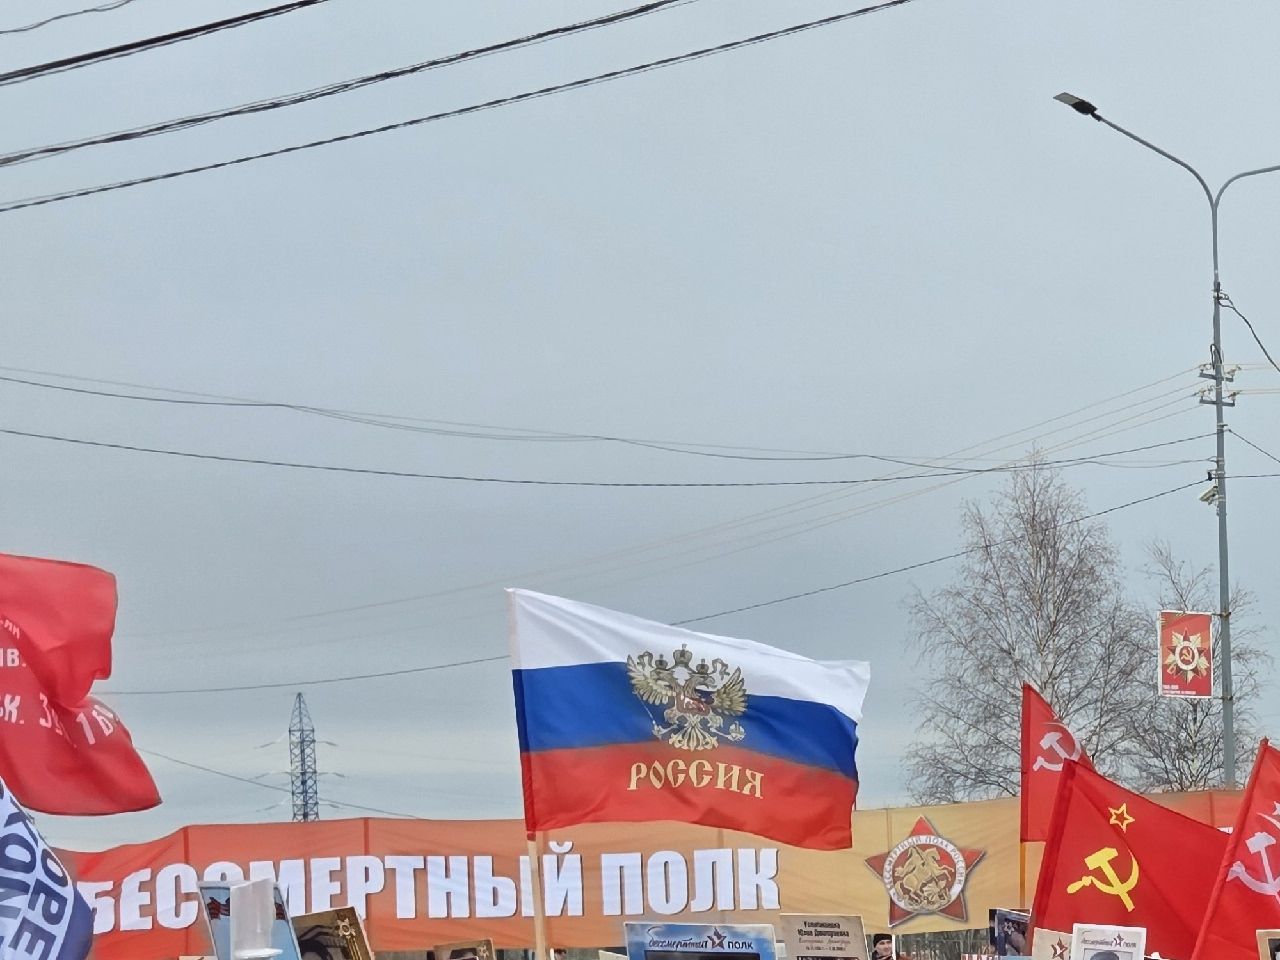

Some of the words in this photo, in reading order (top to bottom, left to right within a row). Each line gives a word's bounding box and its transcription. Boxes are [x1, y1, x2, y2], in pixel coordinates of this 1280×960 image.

[627, 759, 764, 799] РОССИЯ
[601, 848, 781, 916] ПОЛК
[727, 941, 754, 950] ПОЛК
